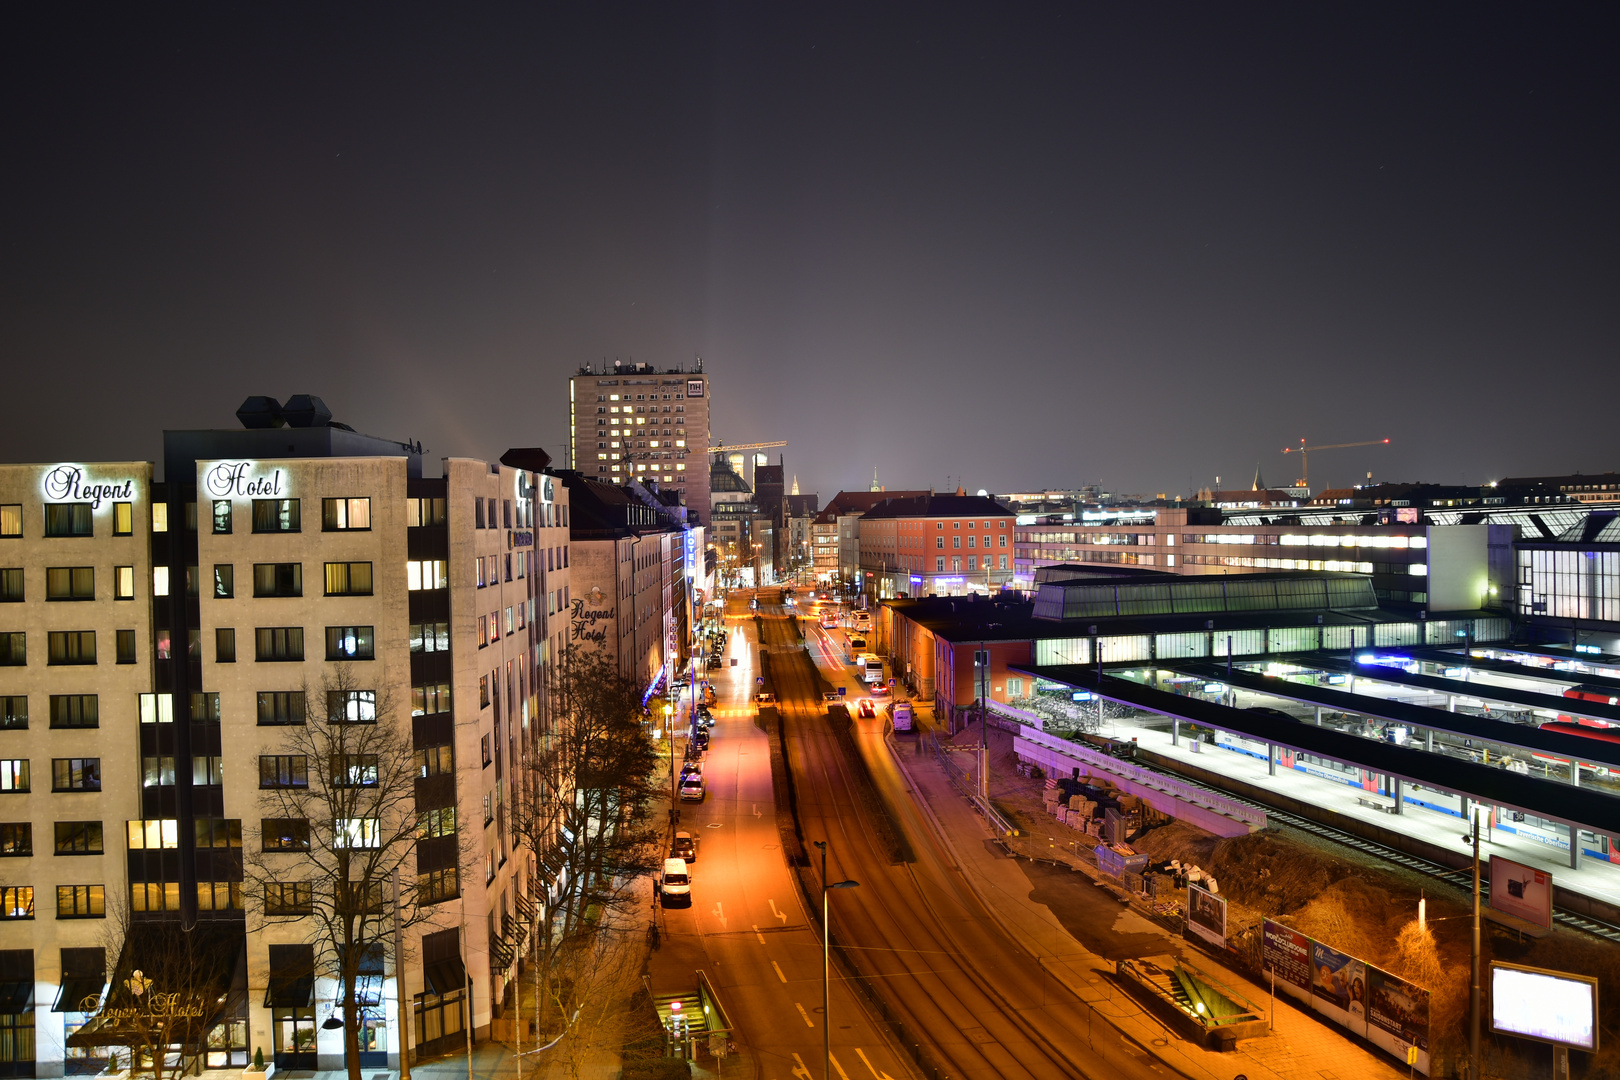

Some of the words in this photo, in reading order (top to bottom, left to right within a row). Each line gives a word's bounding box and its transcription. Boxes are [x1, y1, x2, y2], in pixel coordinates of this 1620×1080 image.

[653, 385, 684, 393] HOTEL
[44, 465, 132, 510] Regent
[206, 462, 282, 497] Hotel
[687, 530, 695, 569] HOTEL
[570, 599, 616, 625] Regent
[571, 620, 607, 641] Hotel
[1516, 829, 1544, 843] Bayerische
[148, 992, 205, 1017] Hotel
